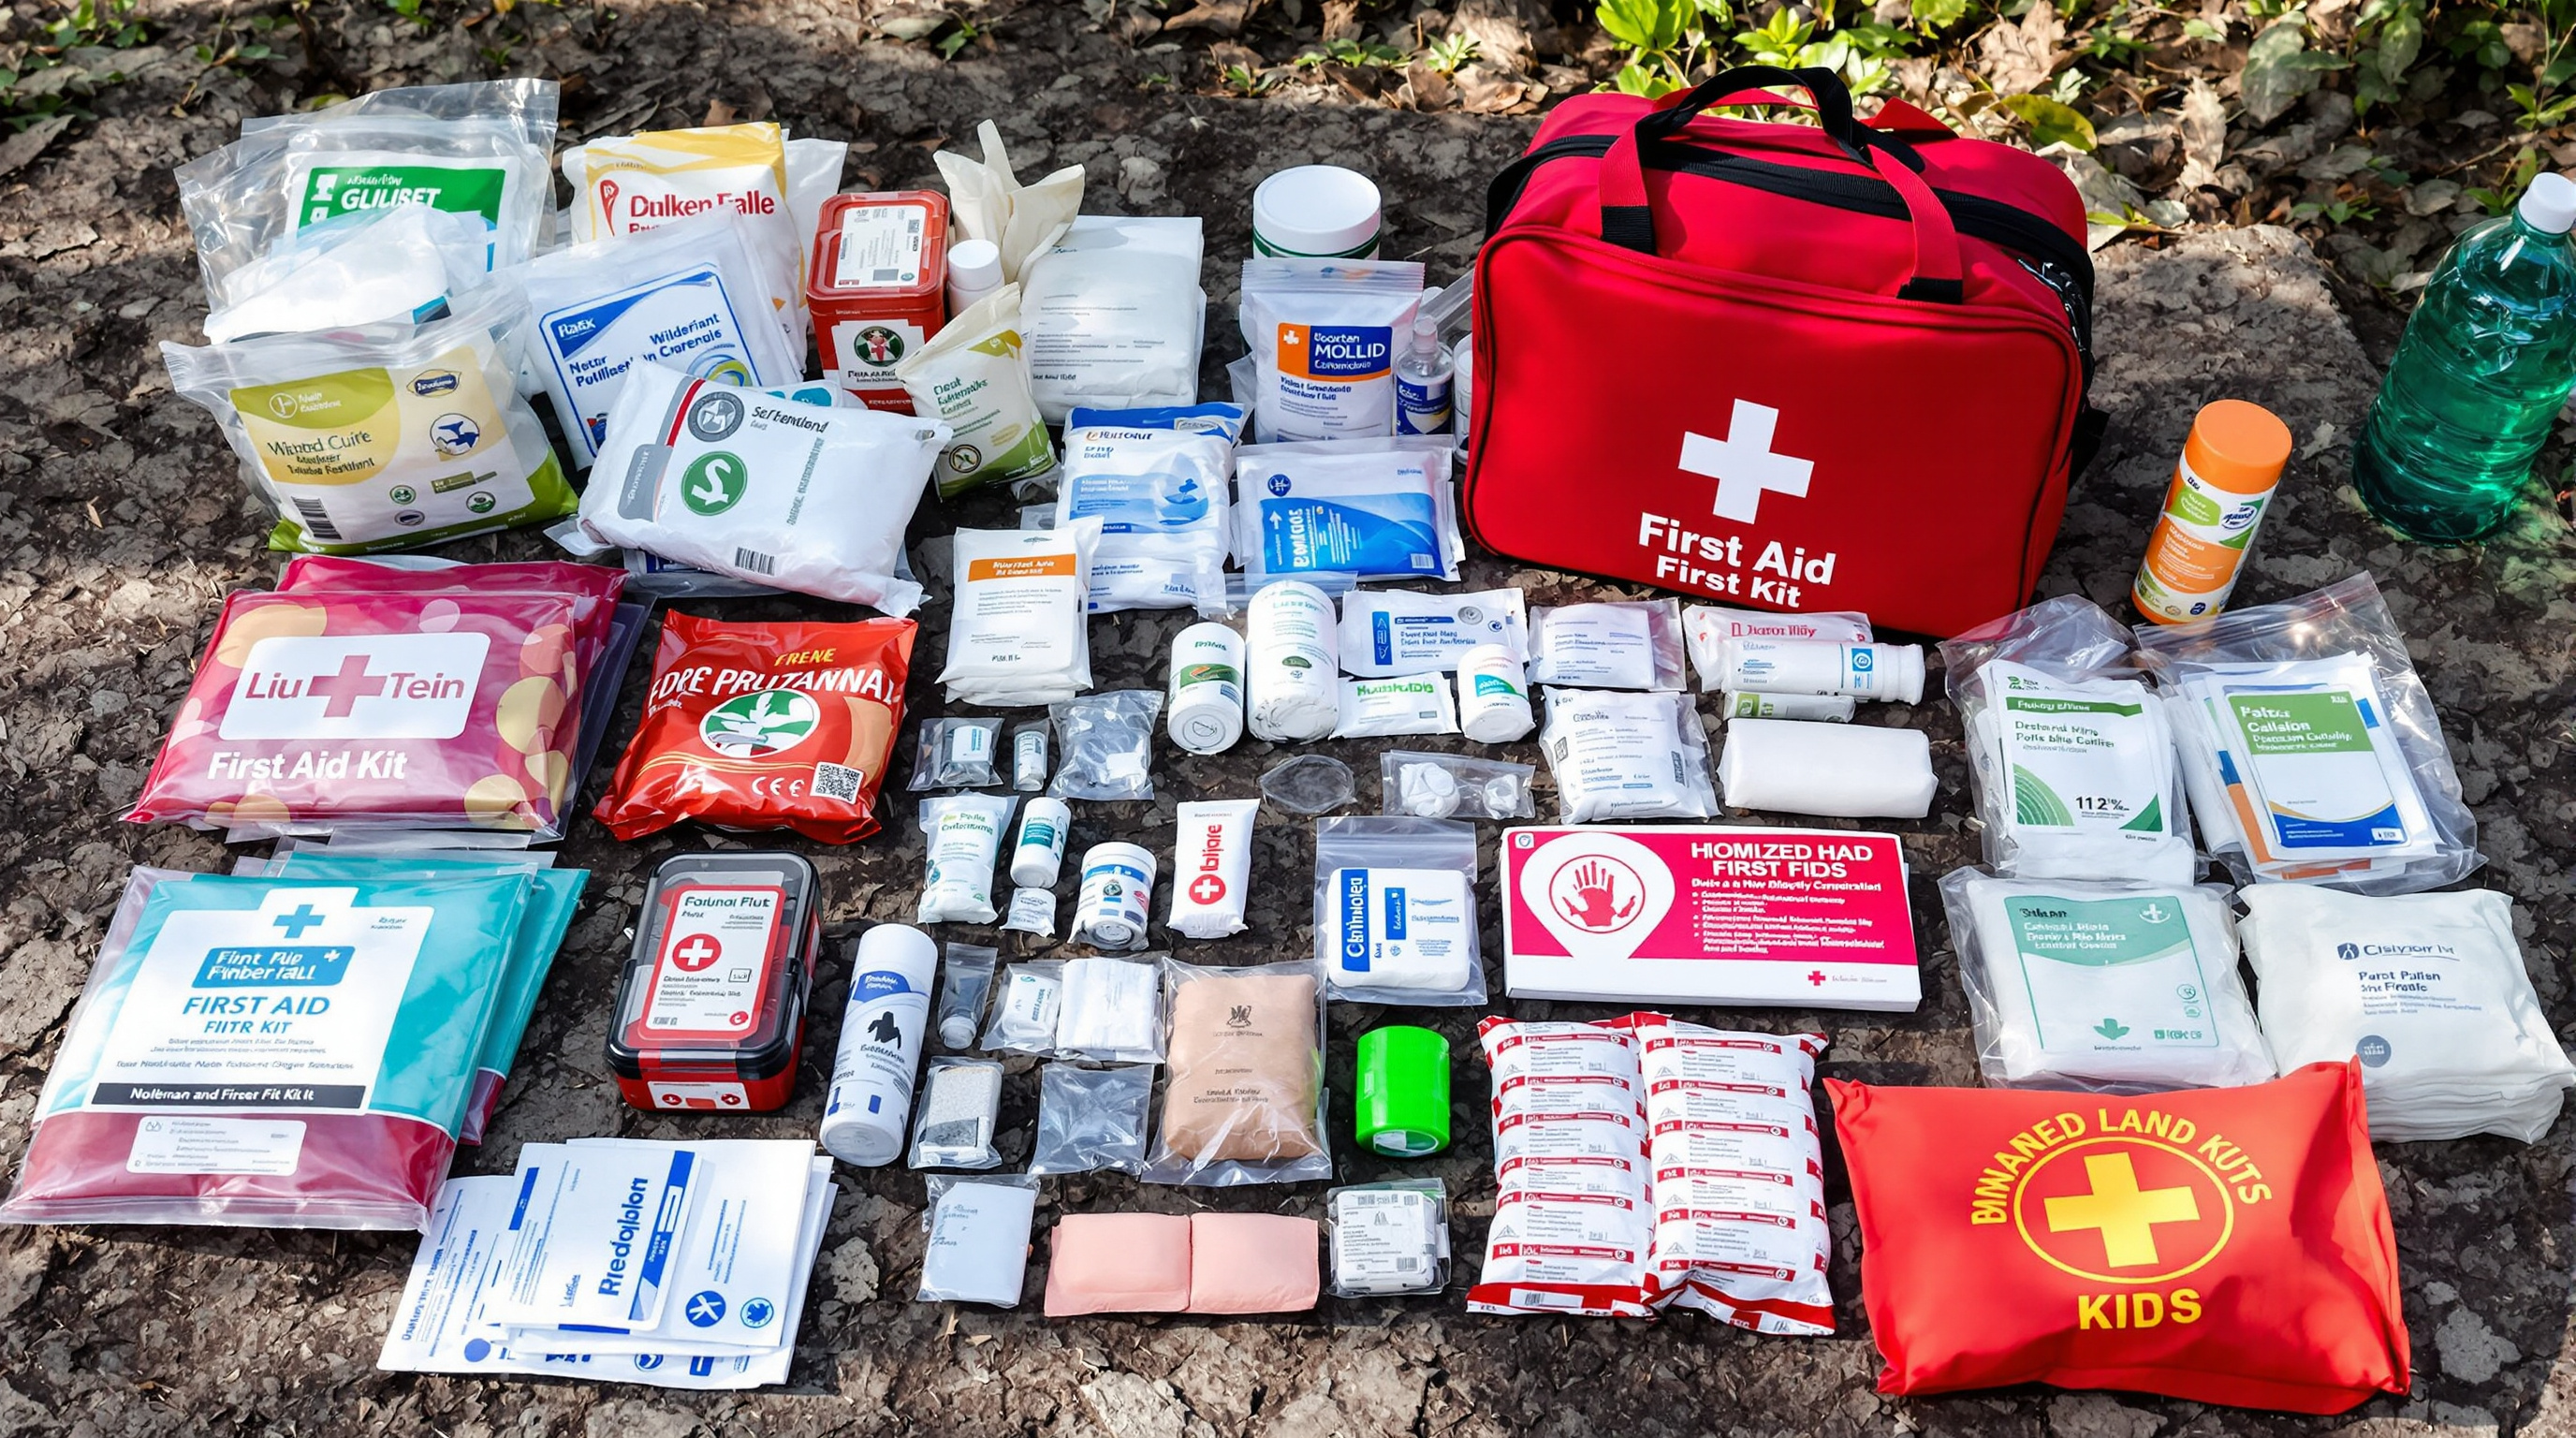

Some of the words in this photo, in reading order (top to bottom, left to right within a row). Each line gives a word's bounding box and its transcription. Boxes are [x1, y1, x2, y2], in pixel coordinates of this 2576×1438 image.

[1315, 343, 1385, 360] MOLLID
[1639, 512, 1743, 567] First
[1752, 540, 1837, 585] Aid
[1656, 554, 1740, 595] First
[1750, 576, 1801, 609] Kit
[245, 672, 301, 699] Liu
[389, 672, 465, 699] Tein
[207, 752, 285, 780] First
[289, 750, 349, 779] Aid
[358, 749, 407, 779] Kit
[1818, 844, 1873, 861] HAD
[1712, 859, 1780, 876] FIRST
[1788, 861, 1848, 878] FIDS
[182, 996, 269, 1015] FIRST
[270, 996, 330, 1015] AID
[259, 1020, 293, 1034] KIT
[193, 1088, 220, 1100] and
[2098, 1108, 2197, 1144] LAND
[2197, 1133, 2273, 1206] KUTS
[2078, 1288, 2203, 1330] KIDS
